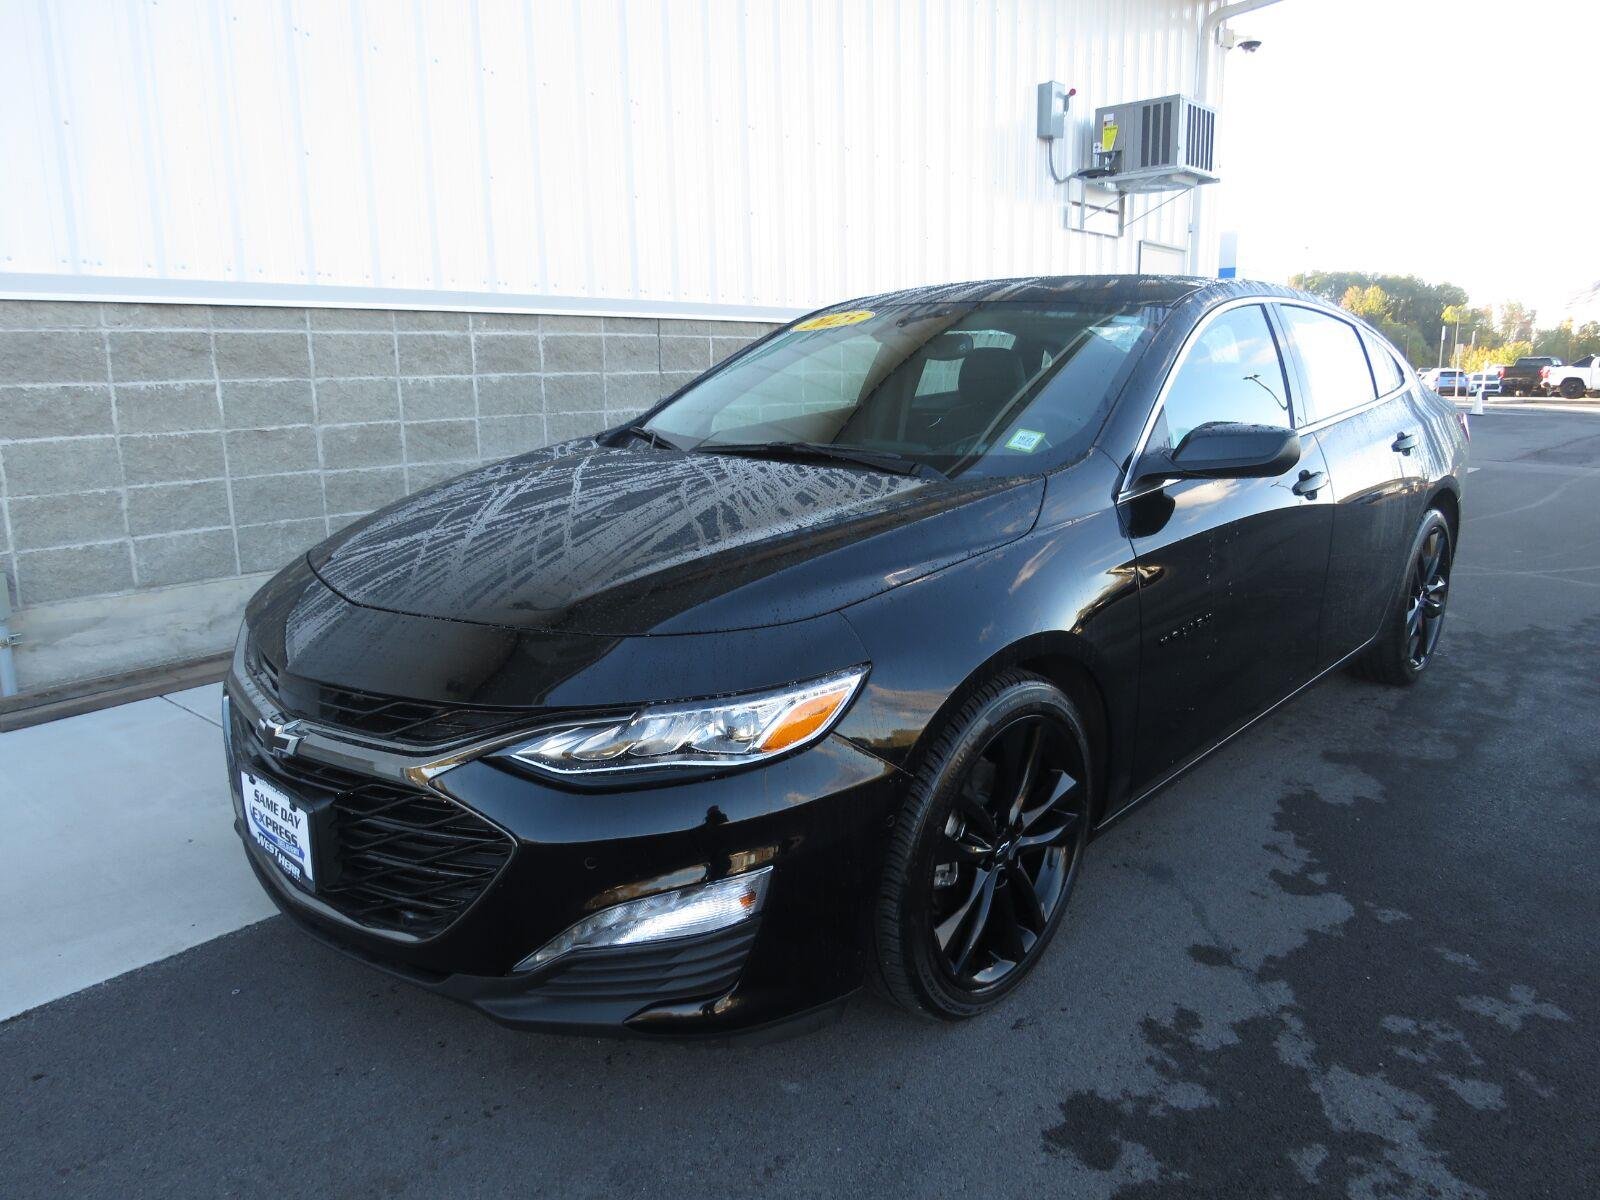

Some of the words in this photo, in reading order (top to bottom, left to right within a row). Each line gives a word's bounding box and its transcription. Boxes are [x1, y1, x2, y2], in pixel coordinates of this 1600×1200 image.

[252, 807, 298, 845] EXPRESS
[254, 789, 279, 814] SAME
[280, 808, 302, 829] DAY
[257, 832, 279, 856] WEST
